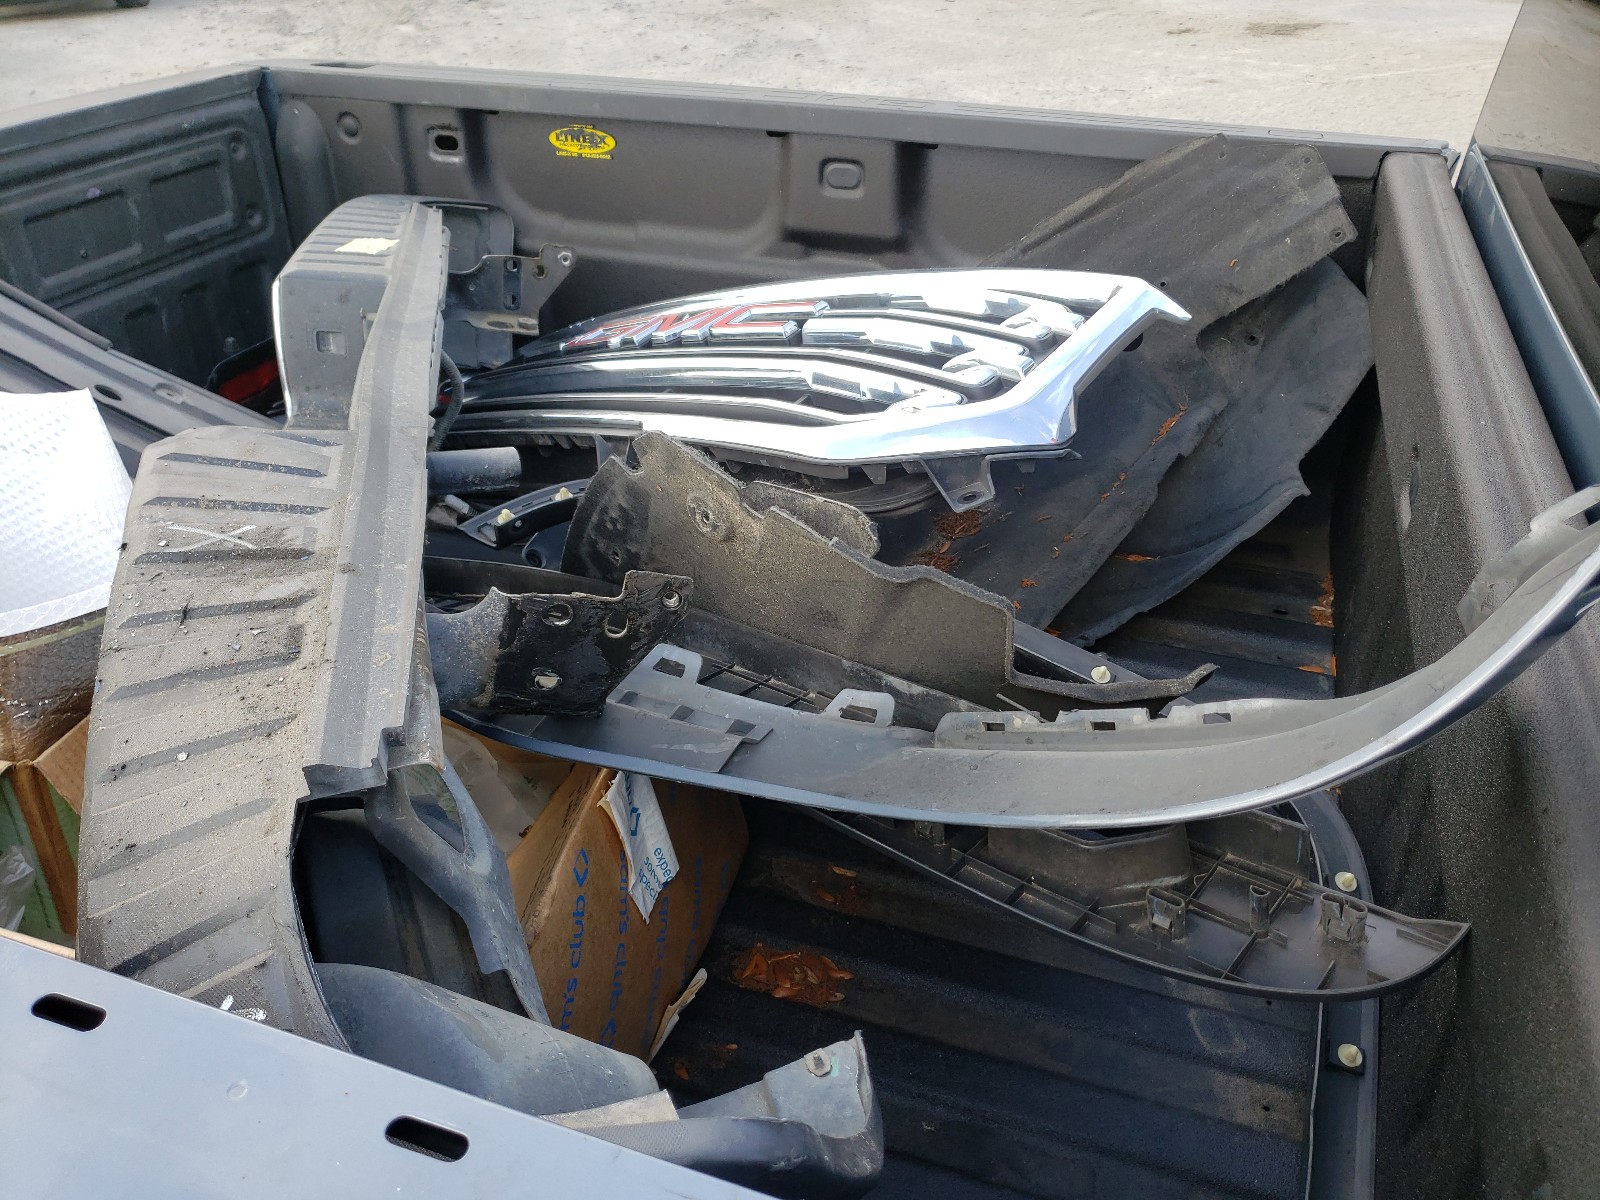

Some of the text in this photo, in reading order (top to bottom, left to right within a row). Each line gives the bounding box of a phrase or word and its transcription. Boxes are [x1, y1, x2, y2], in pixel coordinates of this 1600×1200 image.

[559, 299, 830, 349] GMC
[559, 894, 587, 1031] m's club
[610, 942, 627, 1012] club
